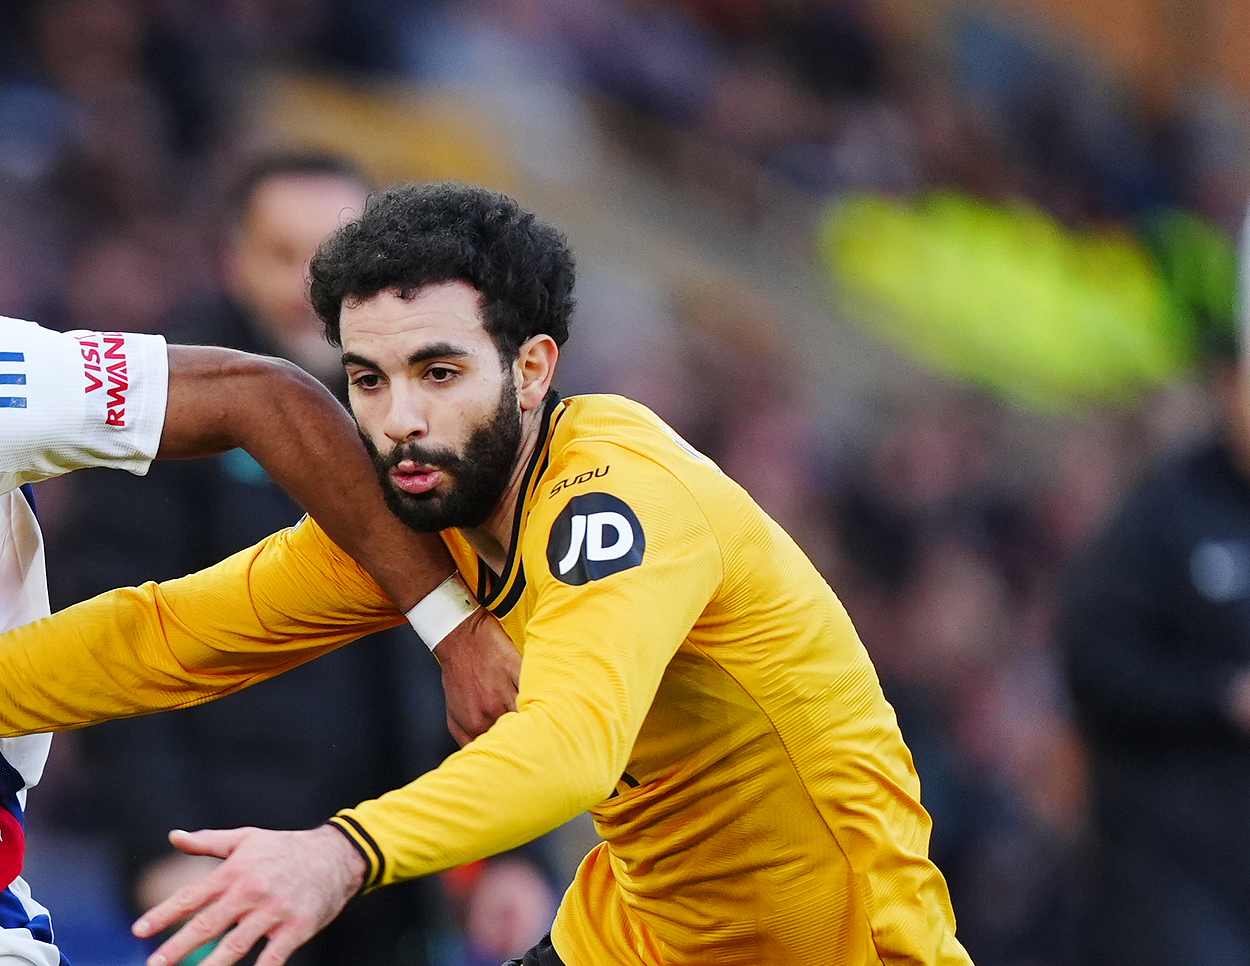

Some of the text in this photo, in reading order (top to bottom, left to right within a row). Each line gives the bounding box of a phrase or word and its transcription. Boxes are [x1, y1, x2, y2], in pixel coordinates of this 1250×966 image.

[74, 334, 103, 394] VISI
[548, 465, 610, 499] SUDU
[558, 511, 635, 575] JD
